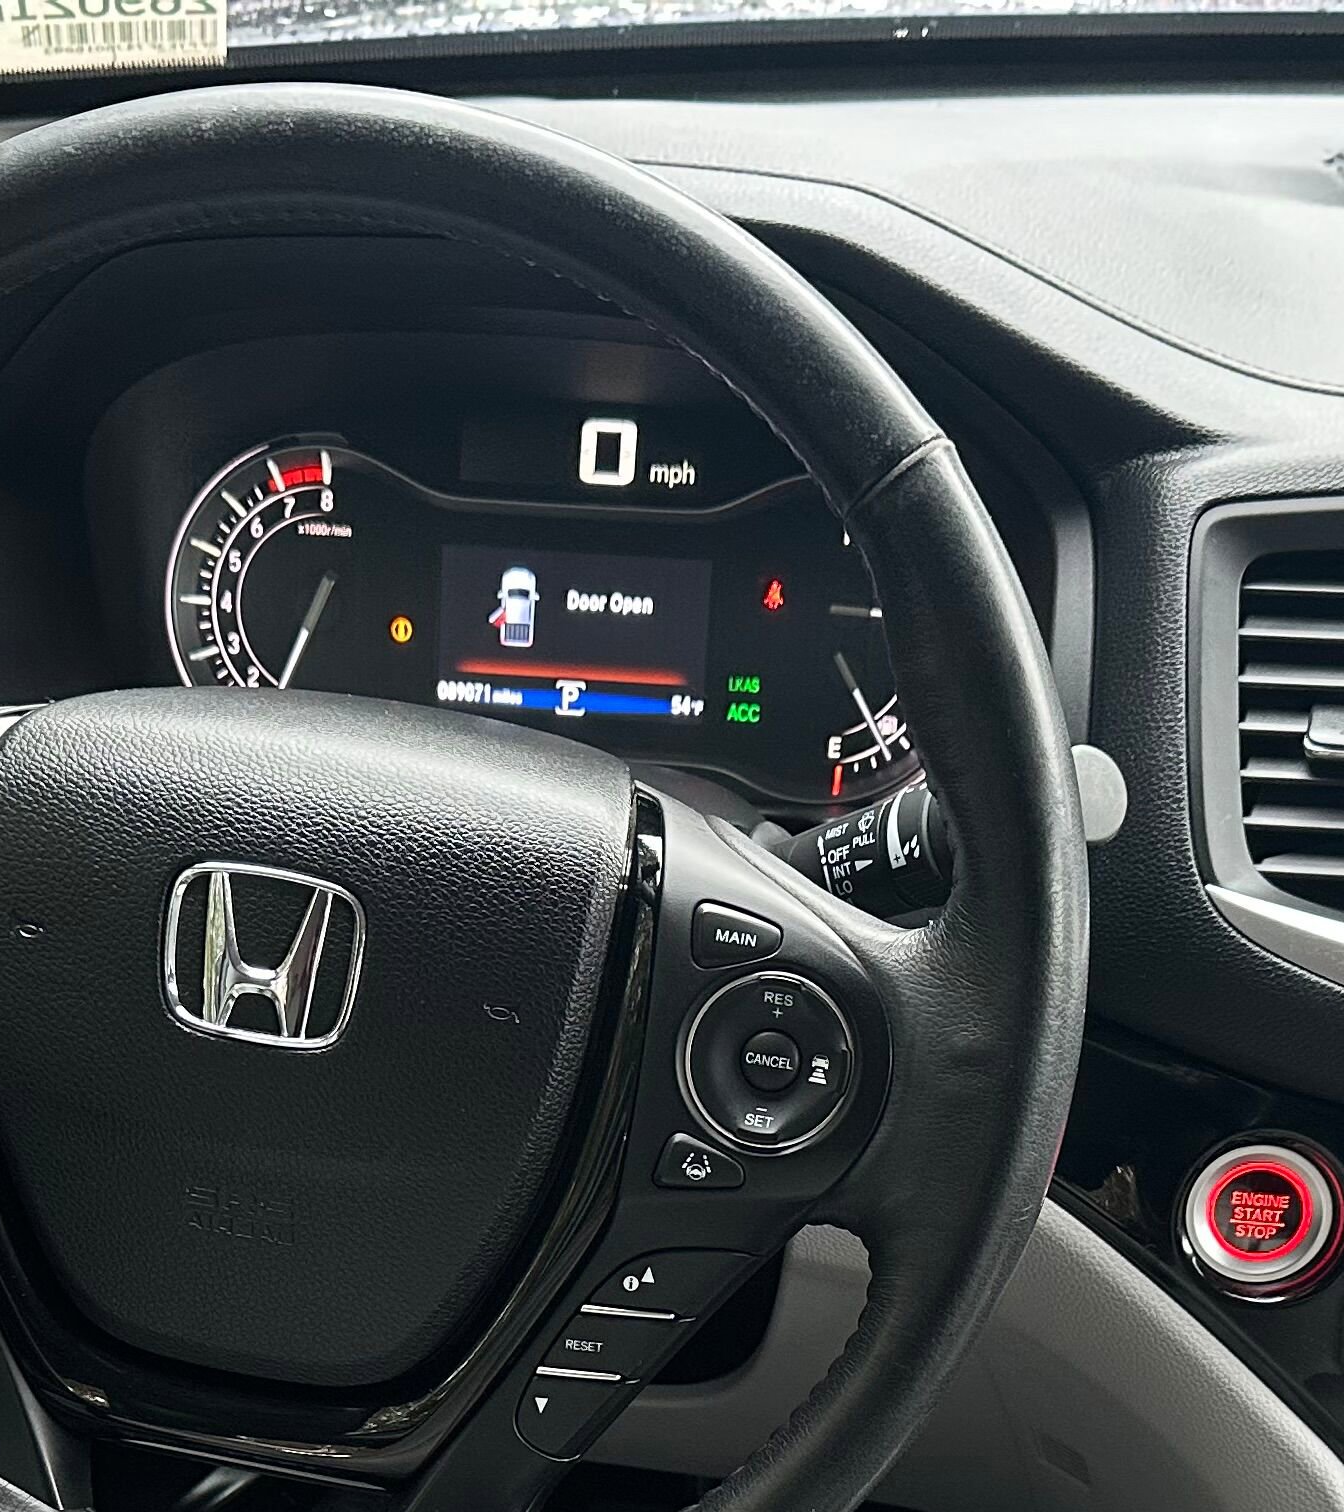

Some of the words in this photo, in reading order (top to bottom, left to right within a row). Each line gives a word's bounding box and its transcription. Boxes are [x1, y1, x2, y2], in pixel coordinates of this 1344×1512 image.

[650, 460, 695, 490] mph
[283, 496, 296, 518] 7
[320, 488, 334, 512] 8
[250, 517, 264, 539] 6
[229, 550, 242, 573] 5
[220, 590, 233, 613] 4
[566, 589, 607, 612] Door
[610, 592, 654, 615] Open
[227, 632, 241, 655] 3
[247, 666, 260, 688] 2
[728, 675, 760, 693] LKAS
[562, 687, 579, 711] P
[726, 703, 760, 723] ACC
[827, 735, 842, 759] E
[825, 822, 849, 840] MIST
[852, 832, 876, 849] PULL
[827, 844, 850, 864] OFF
[832, 861, 851, 880] INT
[715, 928, 757, 947] MAIN
[764, 991, 794, 1007] RES
[745, 1052, 794, 1071] CANCEL
[744, 1113, 775, 1129] SET
[1230, 1191, 1290, 1209] ENGINE
[1233, 1207, 1284, 1223] START
[1235, 1225, 1277, 1239] STOP
[565, 1338, 604, 1353] RESET
